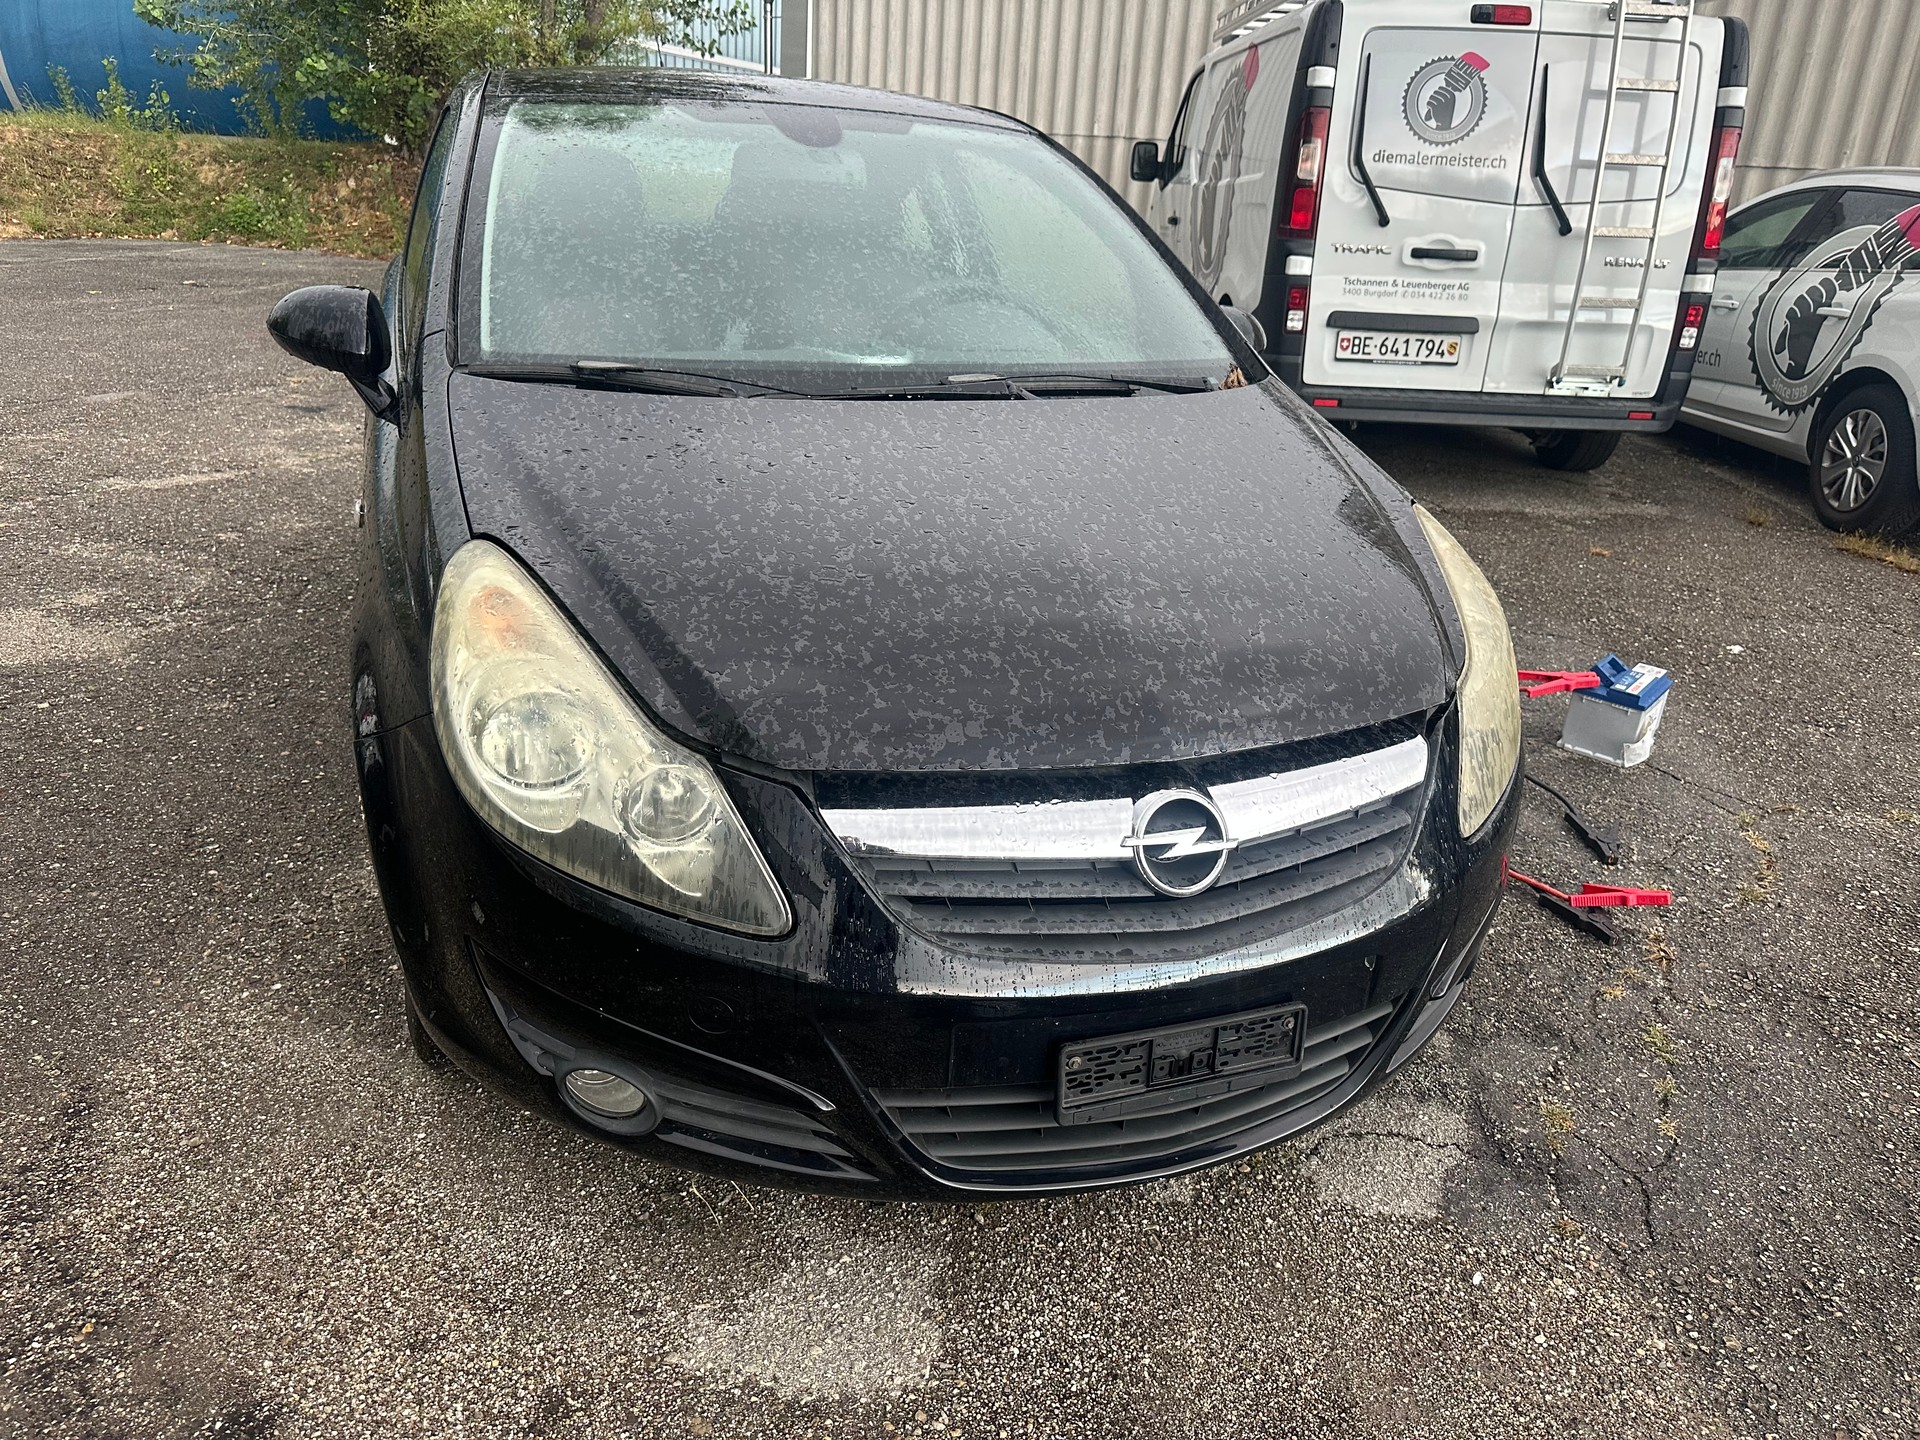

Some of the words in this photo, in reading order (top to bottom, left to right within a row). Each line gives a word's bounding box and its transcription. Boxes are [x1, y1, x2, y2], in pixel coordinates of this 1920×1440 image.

[1372, 149, 1507, 169] diemalermeister.ch
[1331, 243, 1392, 255] TRAFIC
[1604, 256, 1671, 269] RENALT
[1343, 277, 1389, 287] Tschannen
[1391, 279, 1399, 288] &
[1401, 280, 1456, 292] Leuenberger
[1457, 282, 1470, 291] AG
[1342, 288, 1361, 296] 3400
[1363, 288, 1398, 299] Burgdorf
[1410, 290, 1426, 299] 034
[1429, 291, 1443, 300] 422
[1446, 292, 1456, 301] 26
[1693, 348, 1721, 367] er.ch
[1771, 378, 1791, 399] since
[1791, 385, 1808, 400] 1919
